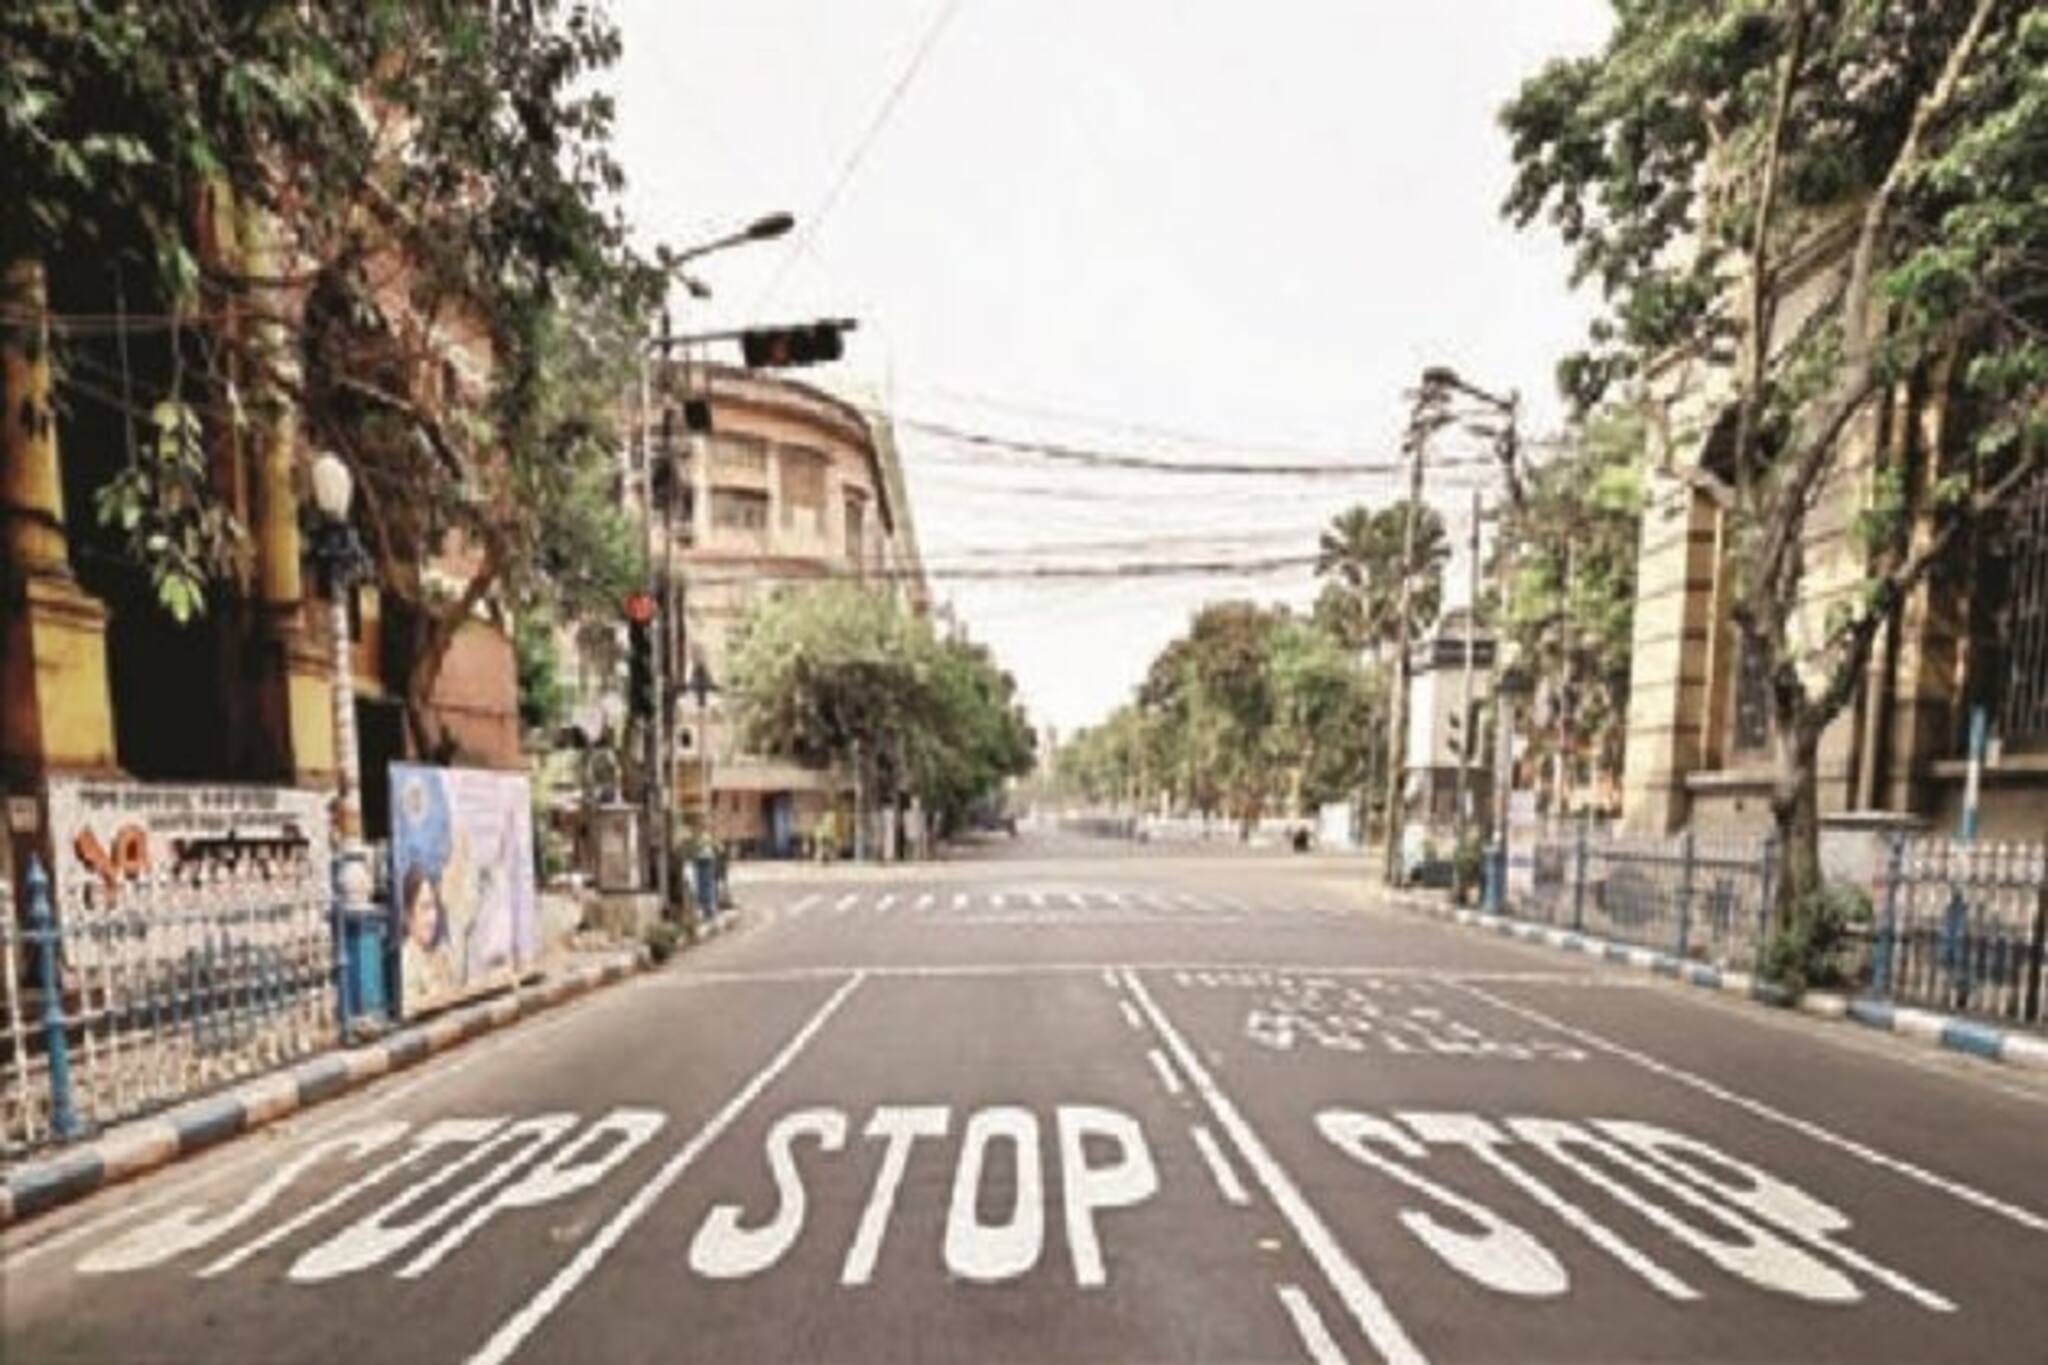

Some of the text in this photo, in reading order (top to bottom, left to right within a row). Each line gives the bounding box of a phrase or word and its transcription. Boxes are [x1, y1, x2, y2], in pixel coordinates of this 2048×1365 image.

[75, 1111, 668, 1281] STOP
[689, 1105, 1159, 1286] STOP
[1314, 1108, 1956, 1311] STOP
